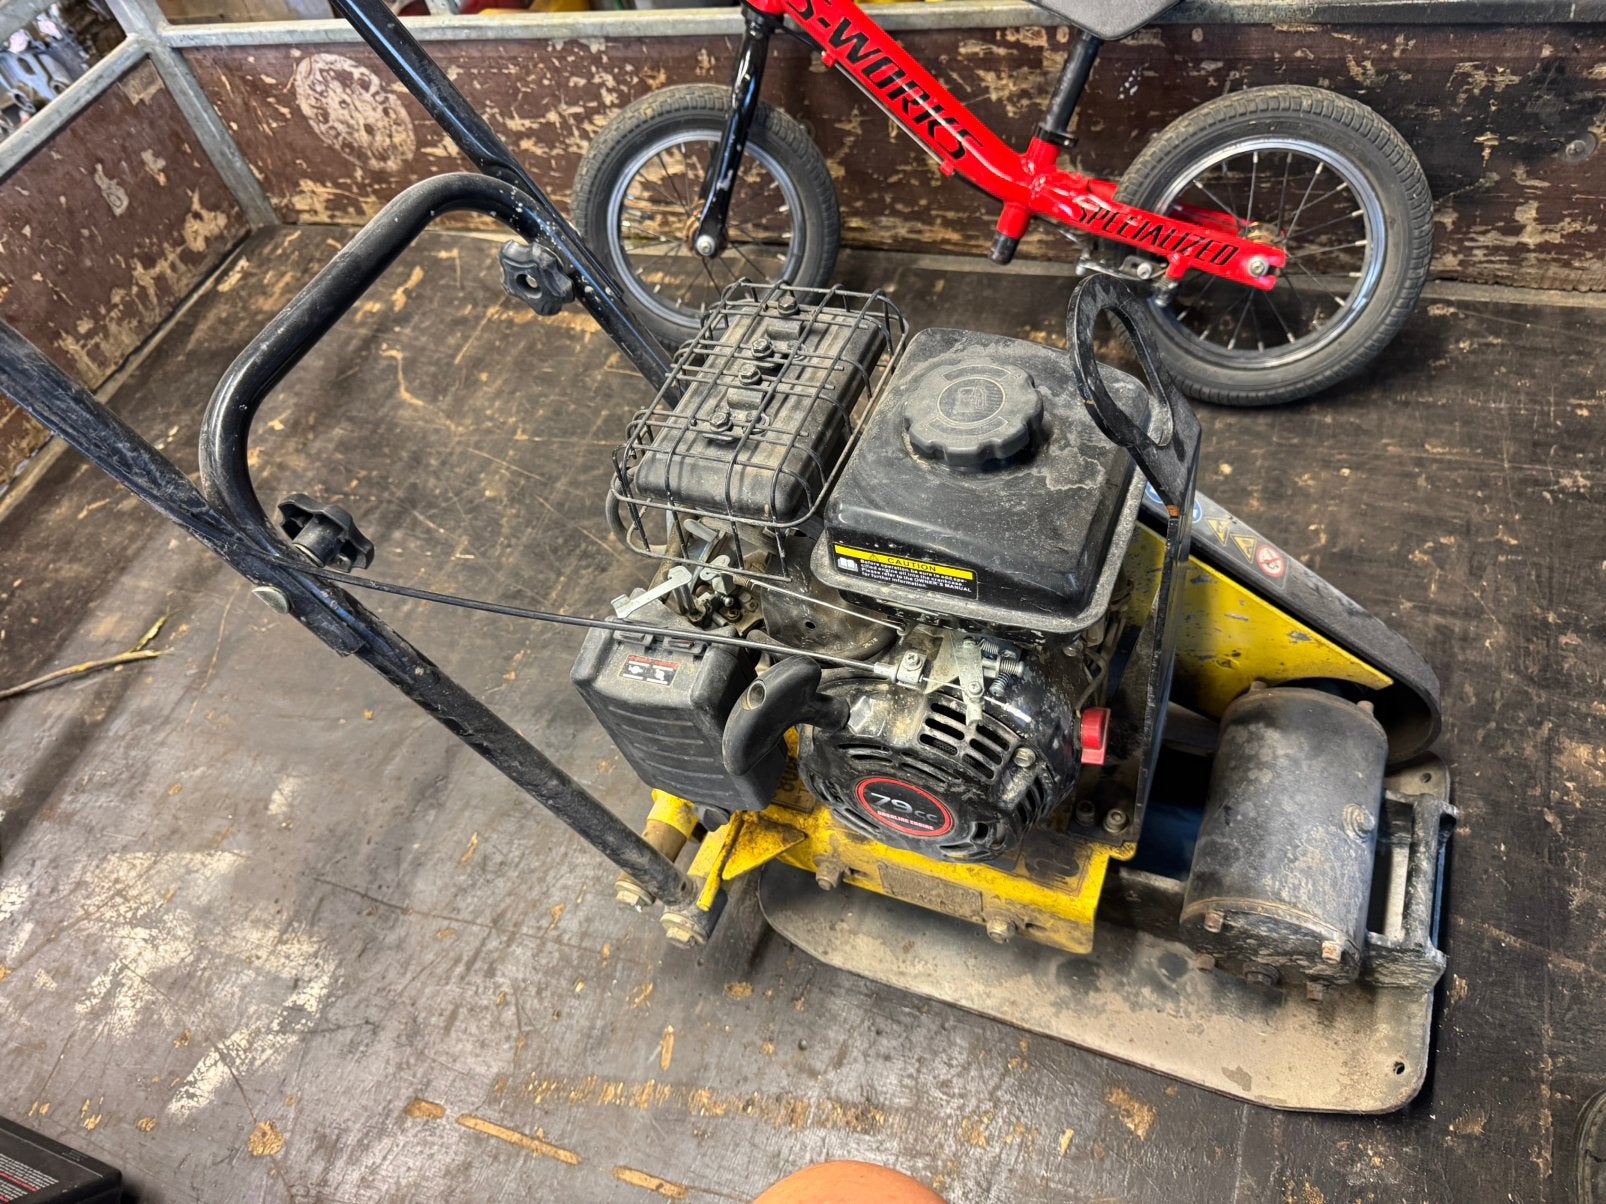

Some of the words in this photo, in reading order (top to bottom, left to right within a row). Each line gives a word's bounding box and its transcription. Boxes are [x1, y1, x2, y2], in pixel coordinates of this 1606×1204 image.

[786, 0, 984, 160] S-WORKS
[1072, 202, 1239, 266] SPECIALIZED
[860, 567, 880, 575] Please
[877, 567, 898, 575] engine
[887, 558, 936, 572] CAUTION
